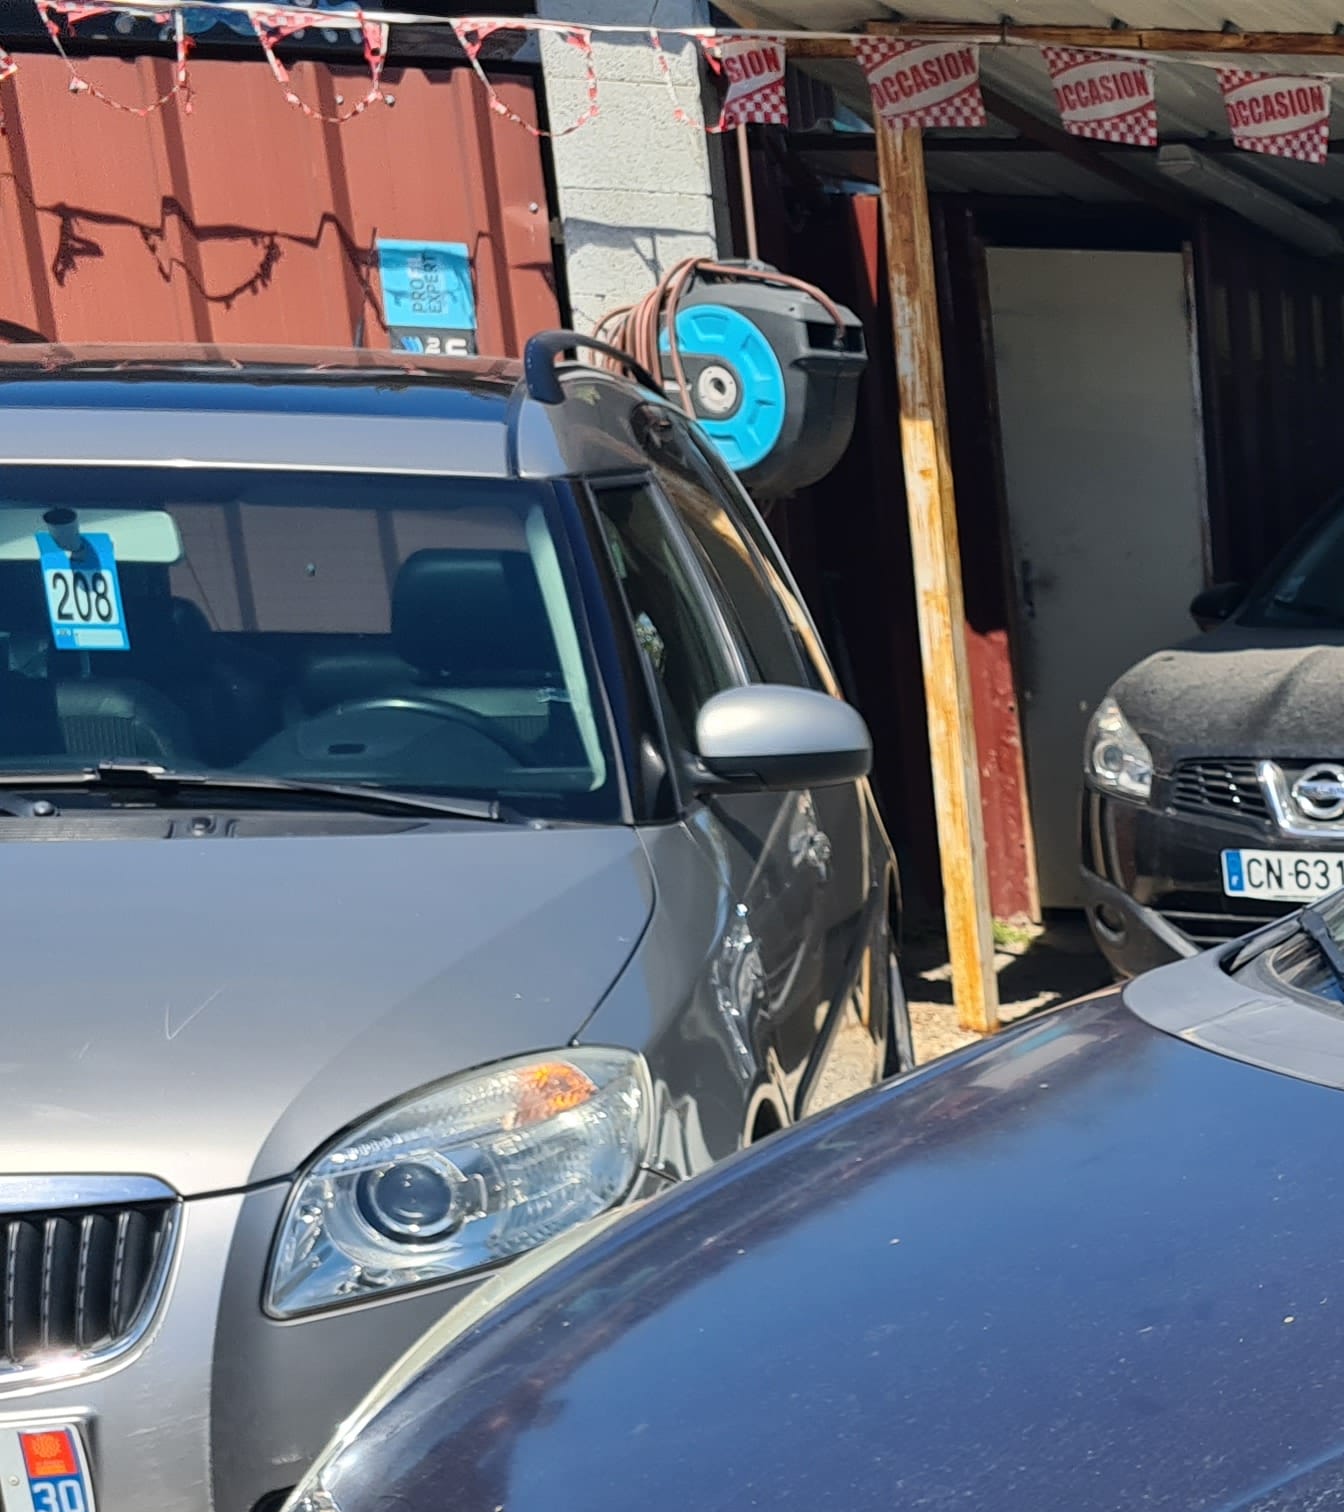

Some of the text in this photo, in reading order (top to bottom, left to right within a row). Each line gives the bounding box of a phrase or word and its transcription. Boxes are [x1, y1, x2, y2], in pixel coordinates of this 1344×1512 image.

[724, 47, 780, 83] SION
[1225, 85, 1324, 128] OCCASION
[422, 252, 442, 313] EXPERT
[53, 571, 112, 622] 208
